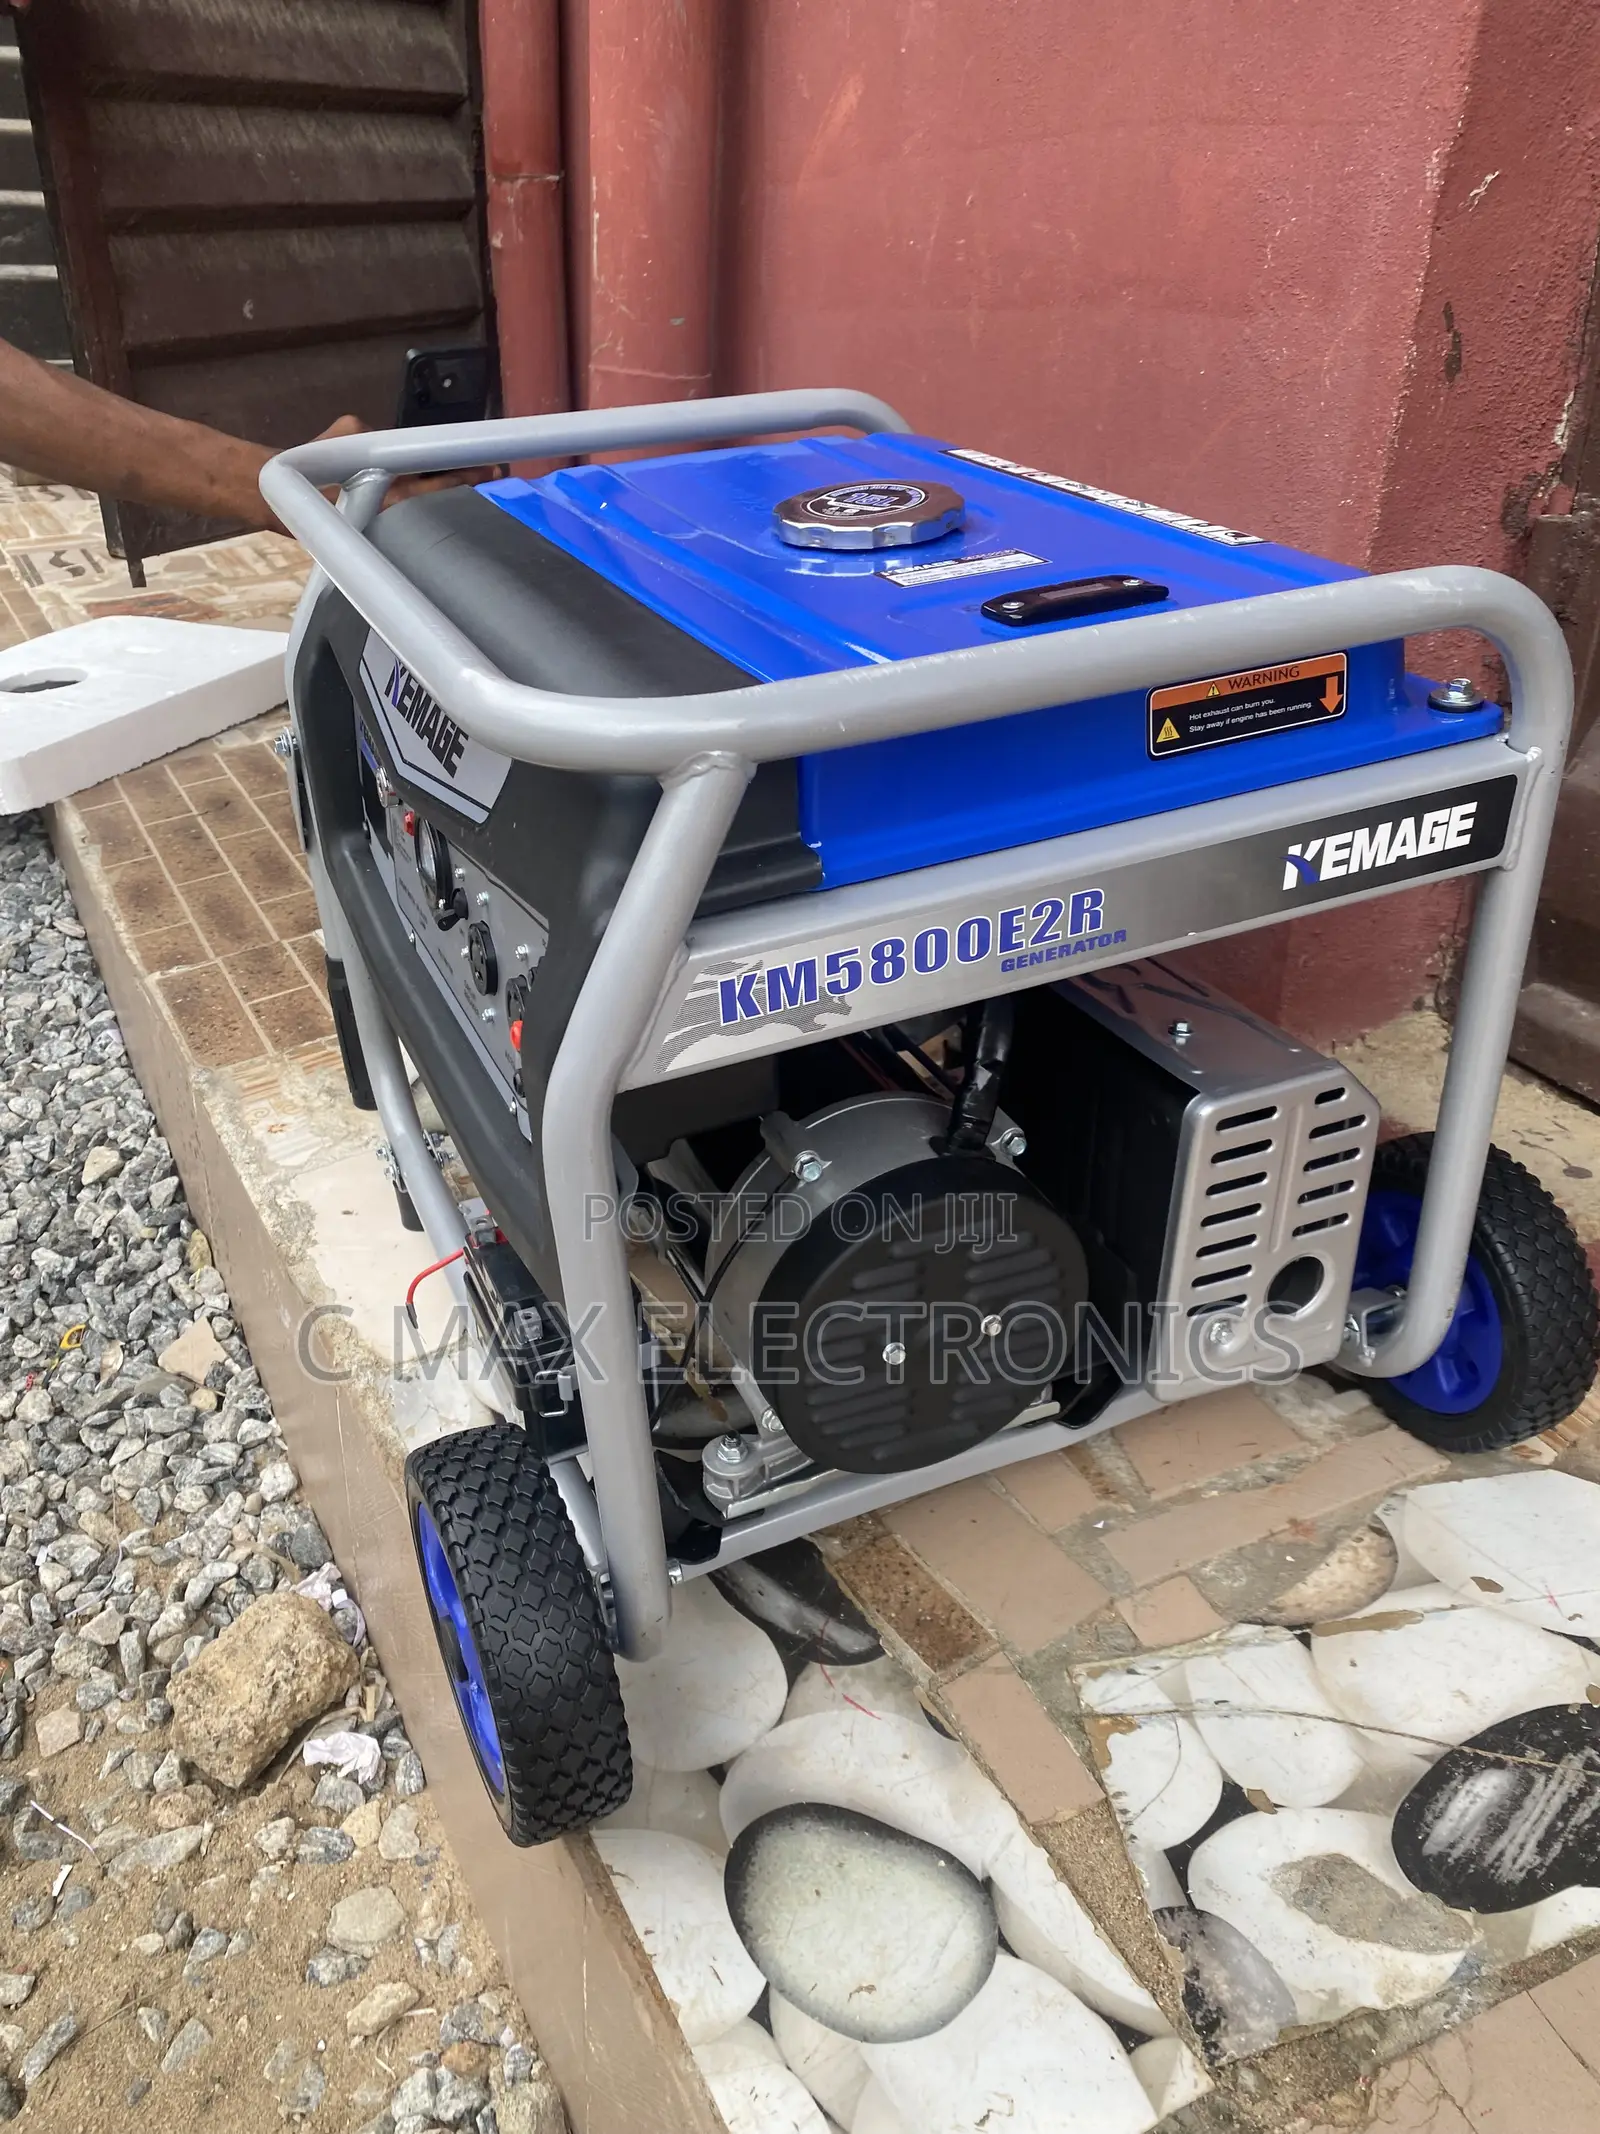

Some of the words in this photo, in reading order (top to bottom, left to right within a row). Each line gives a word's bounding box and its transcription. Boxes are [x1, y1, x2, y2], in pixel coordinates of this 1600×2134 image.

[1228, 666, 1300, 690] WARNING
[384, 658, 469, 779] KEMAGE
[1189, 713, 1202, 721] Hot
[1203, 706, 1230, 718] exhaust
[1189, 723, 1205, 732] Stay
[1206, 721, 1224, 730] away
[1231, 714, 1254, 724] engine
[1254, 711, 1268, 719] has
[1269, 707, 1286, 716] been
[1287, 702, 1312, 713] running.
[1278, 801, 1478, 890] KEMAGE
[719, 888, 1105, 1026] KM5800E2R
[1001, 929, 1127, 973] GENERATOR
